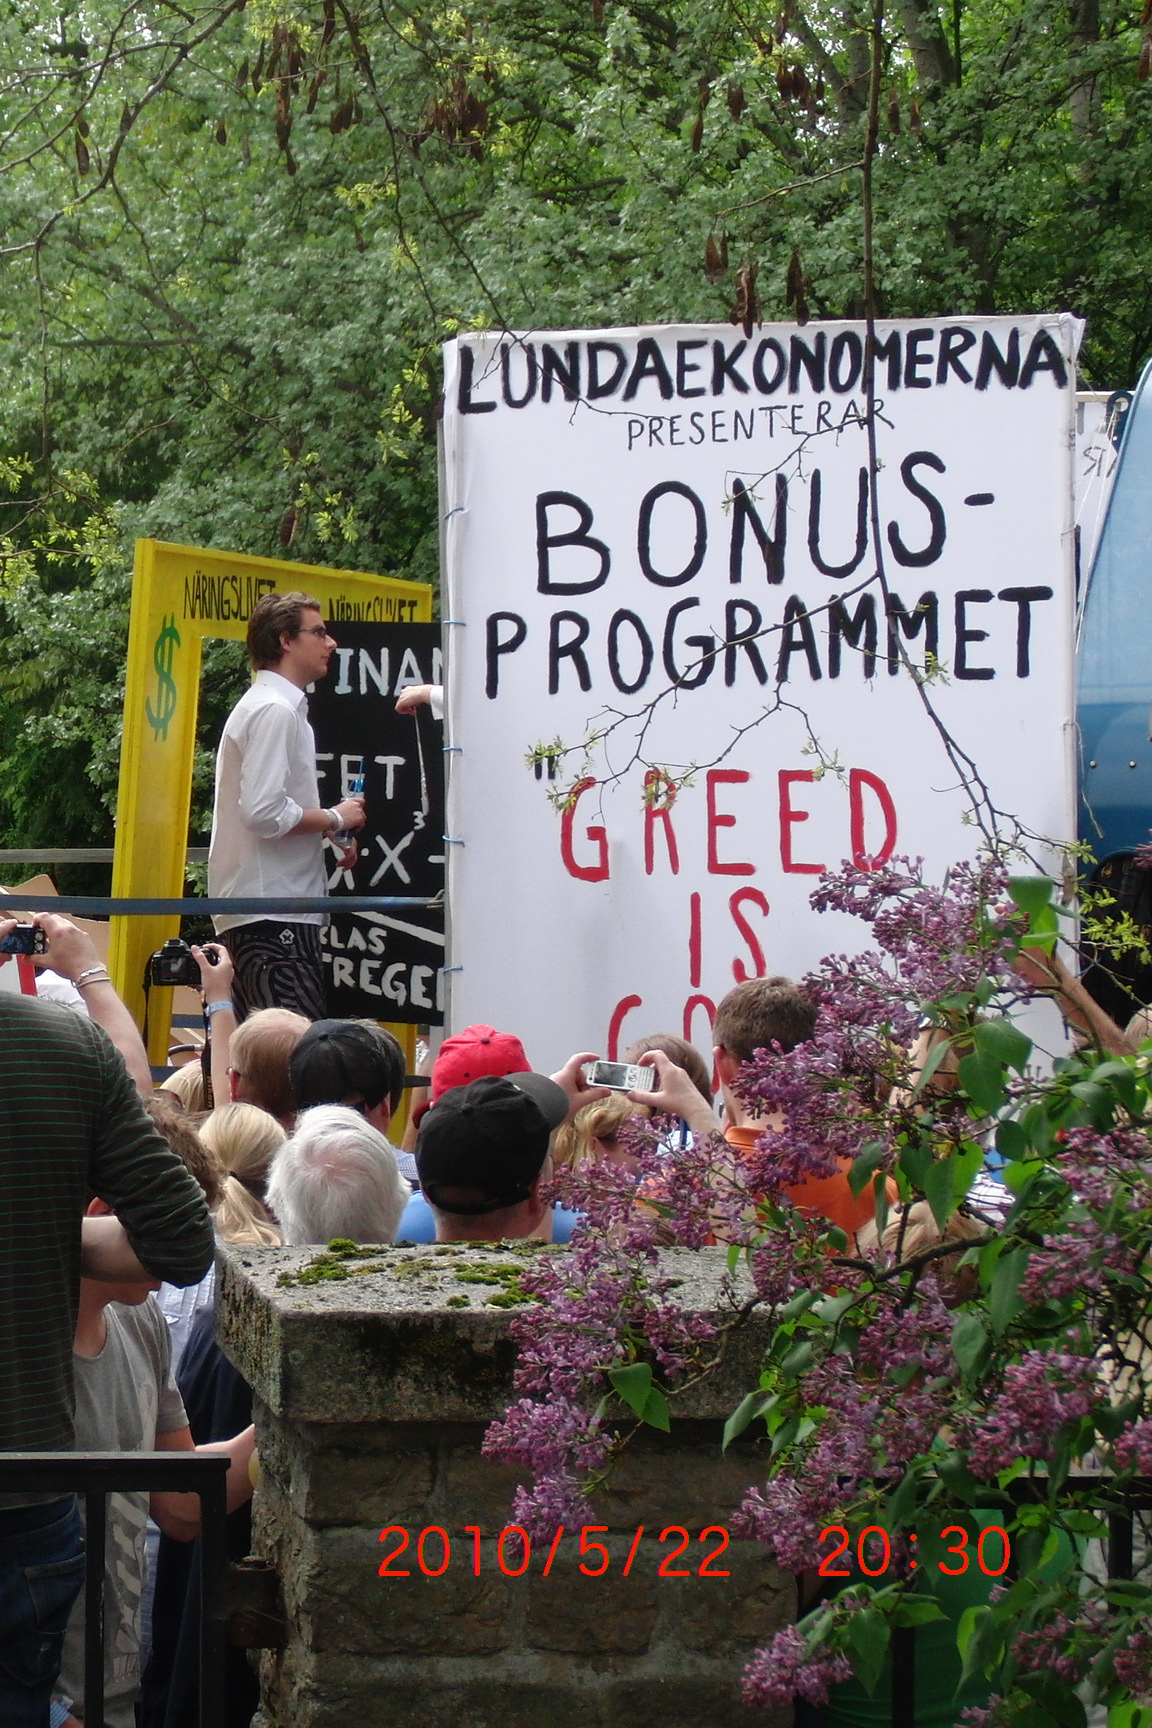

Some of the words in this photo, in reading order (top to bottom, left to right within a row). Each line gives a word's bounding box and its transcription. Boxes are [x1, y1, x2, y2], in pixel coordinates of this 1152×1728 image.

[457, 326, 1068, 415] LUNDAEKONOMERNA
[627, 398, 895, 451] PRESENTERAR
[535, 450, 996, 596] BONUS-
[485, 585, 1054, 700] PROGRAMMET
[688, 886, 771, 989] IS
